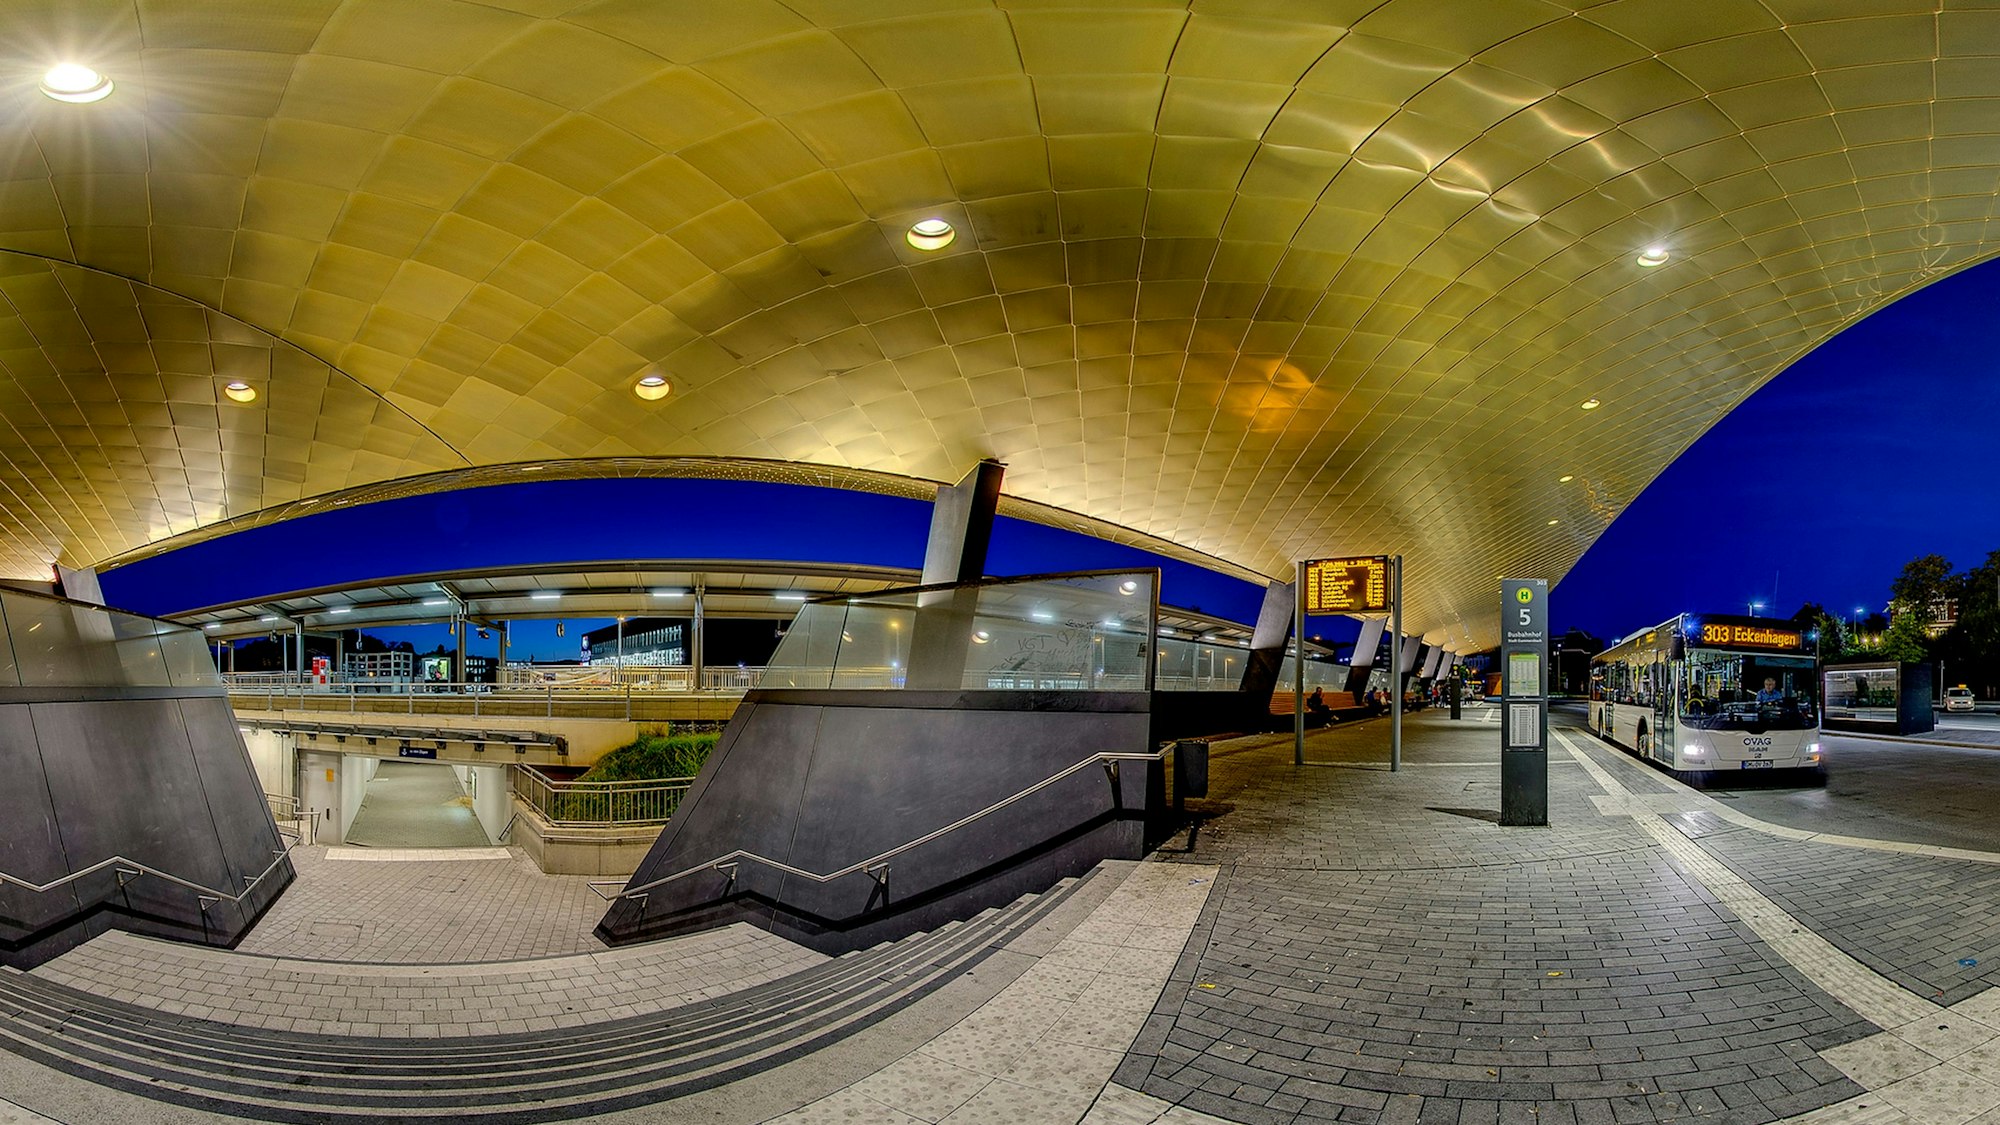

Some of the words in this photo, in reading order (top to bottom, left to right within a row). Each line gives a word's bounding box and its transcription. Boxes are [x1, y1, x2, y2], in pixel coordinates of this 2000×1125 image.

[1521, 591, 1529, 600] H
[1519, 608, 1531, 626] 5
[1703, 625, 1730, 642] 303
[1734, 627, 1796, 647] Eckenhagen
[1743, 737, 1772, 746] OVAG
